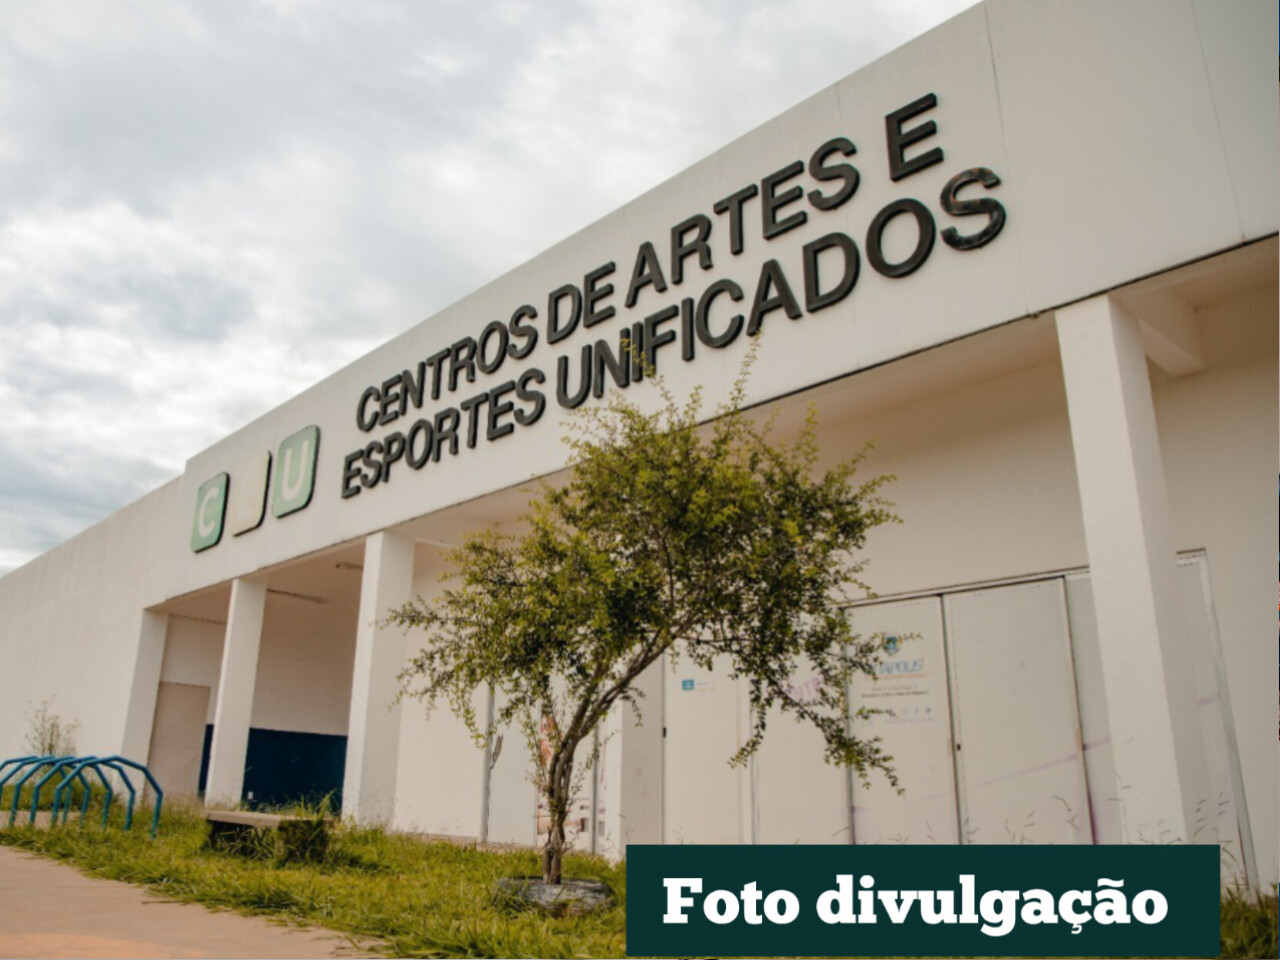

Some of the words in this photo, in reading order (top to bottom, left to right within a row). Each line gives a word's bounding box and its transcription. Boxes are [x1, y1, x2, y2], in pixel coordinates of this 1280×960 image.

[341, 368, 546, 499] ESPORTES
[556, 167, 1006, 410] UNIFICADOS
[357, 304, 538, 432] CENTROS
[547, 261, 616, 345] DE
[624, 137, 860, 308] ARTES
[885, 93, 944, 182] E
